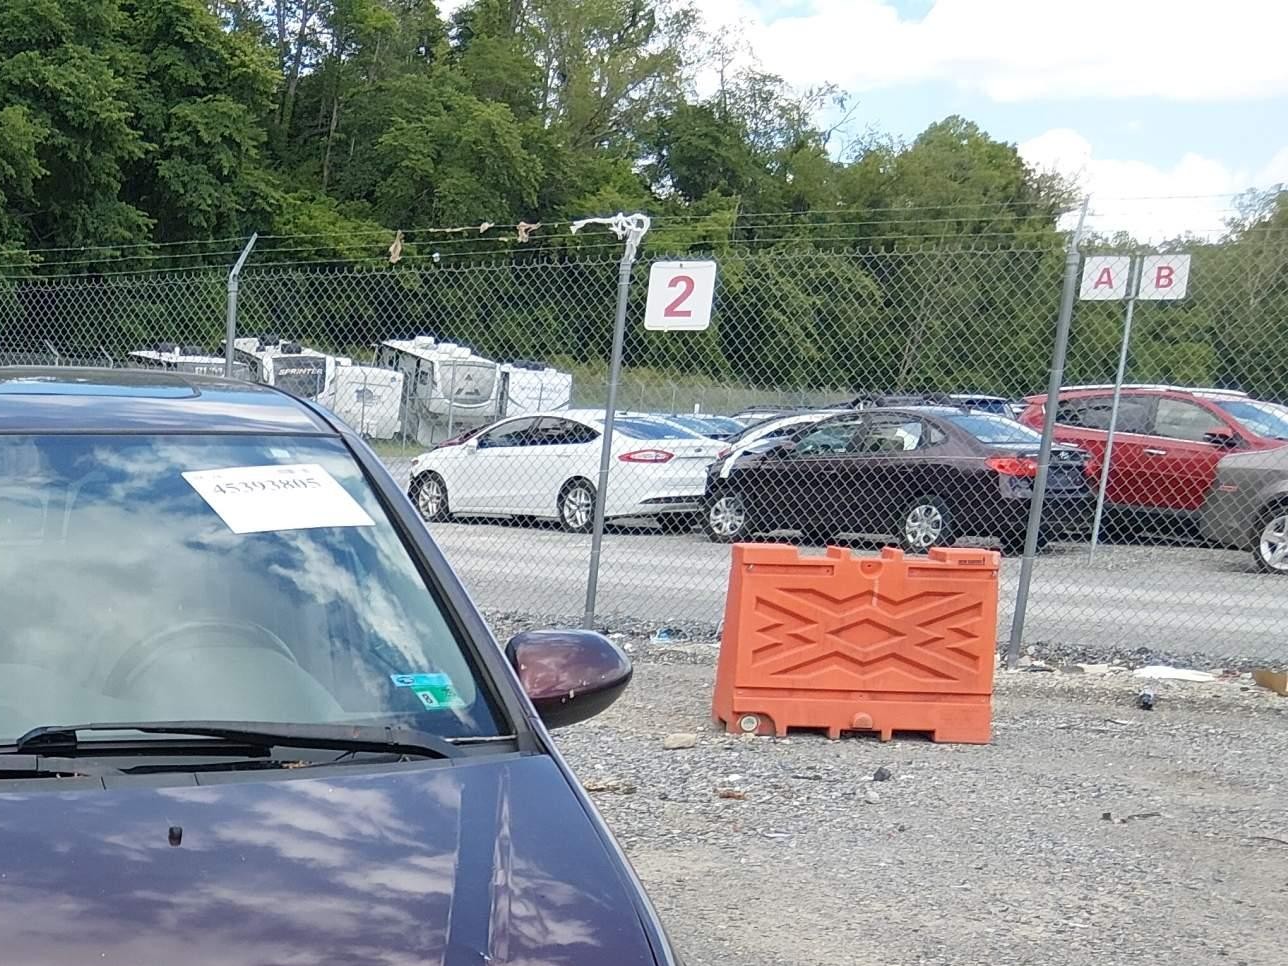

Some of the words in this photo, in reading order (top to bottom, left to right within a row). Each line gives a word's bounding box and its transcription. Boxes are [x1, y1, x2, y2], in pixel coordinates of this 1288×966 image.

[1093, 267, 1114, 290] A
[1155, 265, 1175, 289] B
[663, 274, 696, 318] 2
[214, 477, 322, 495] 45393805
